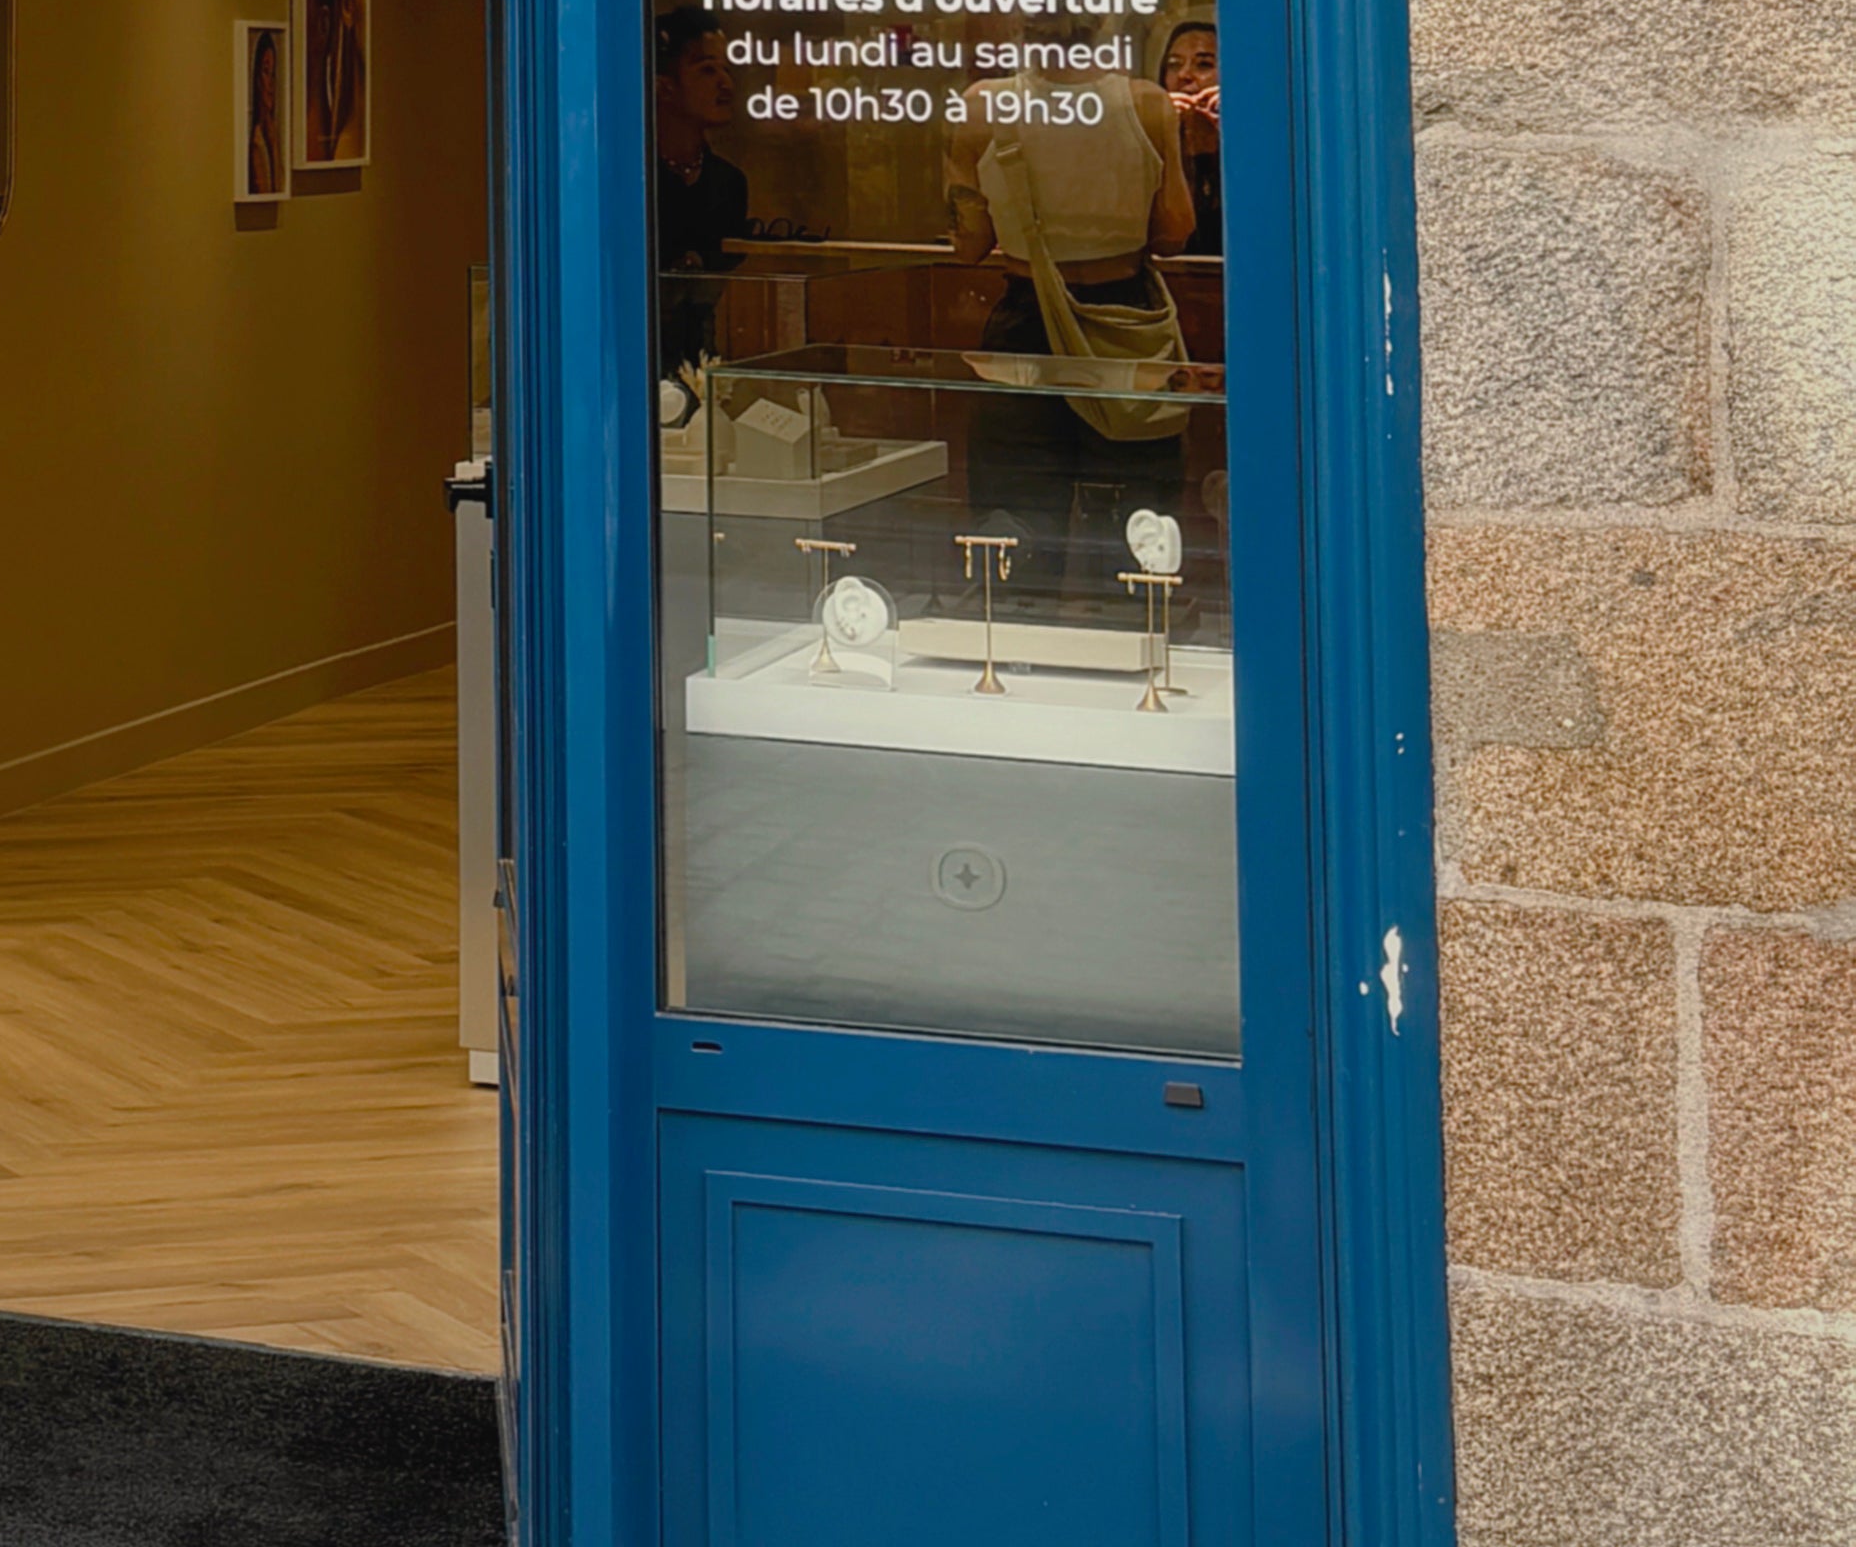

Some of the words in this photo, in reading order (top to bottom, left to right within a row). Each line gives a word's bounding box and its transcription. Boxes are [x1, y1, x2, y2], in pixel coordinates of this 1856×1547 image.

[726, 30, 781, 66] du
[793, 30, 900, 68] lundi
[910, 40, 963, 69] au
[975, 34, 1134, 70] samedi
[746, 84, 800, 121] de
[809, 85, 933, 123] 10h30
[944, 87, 968, 123] à
[979, 89, 1104, 126] 19h30
